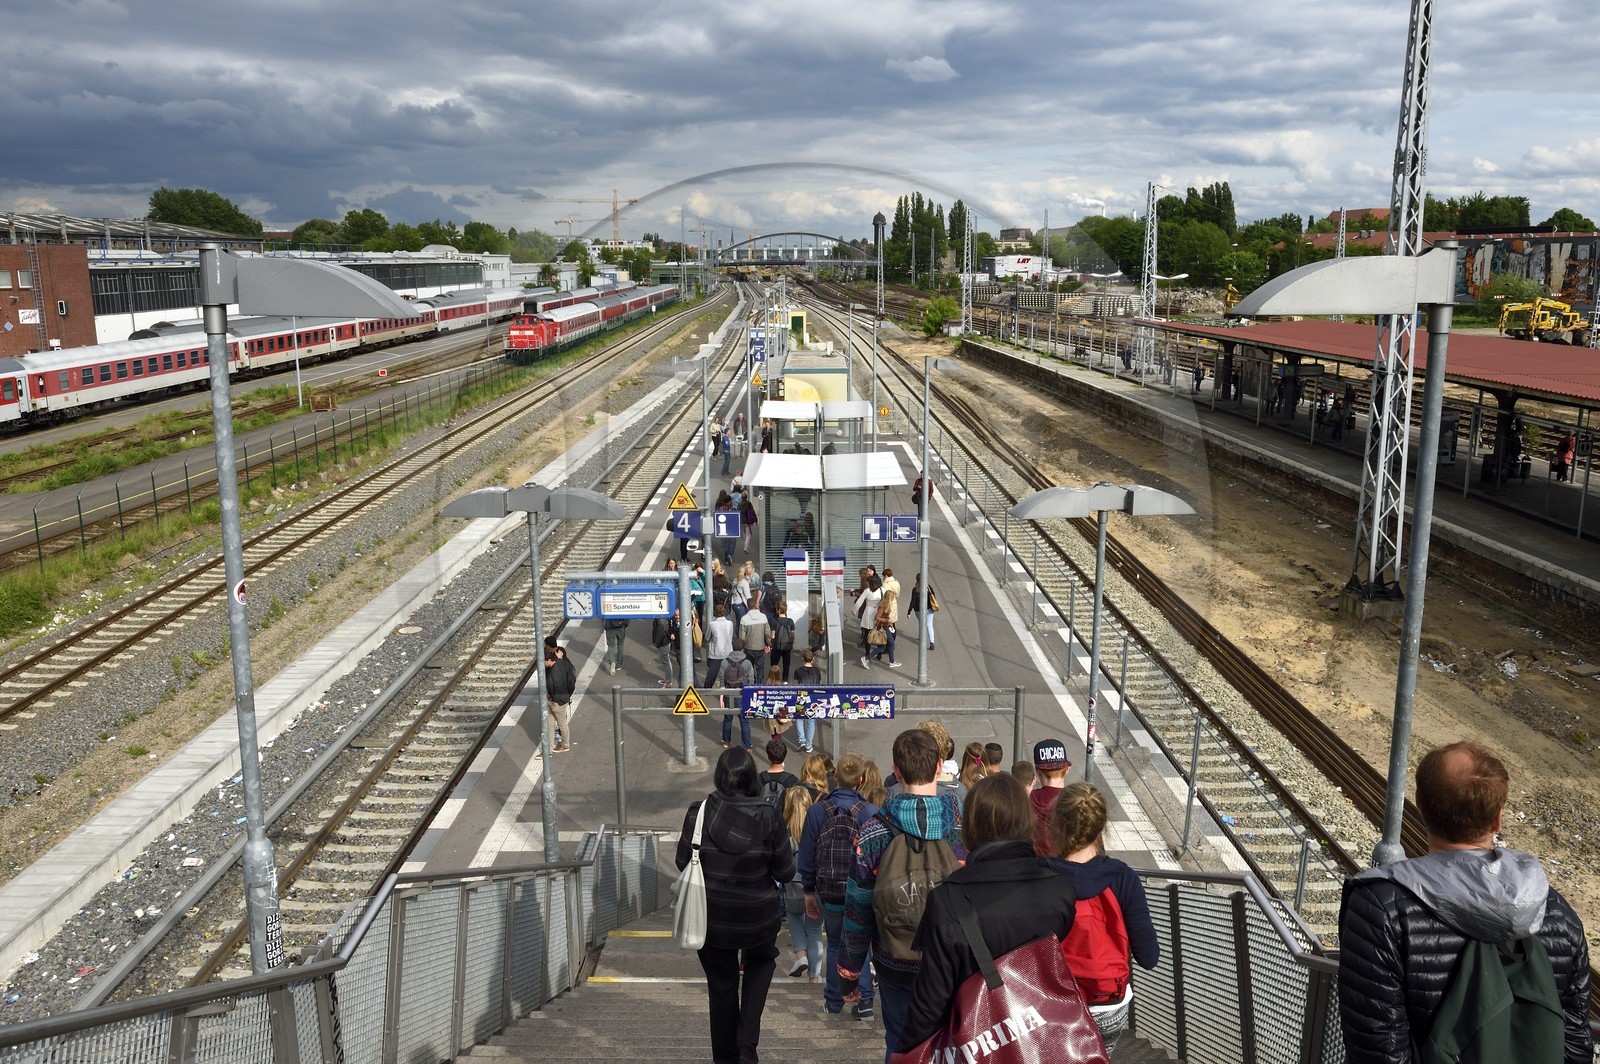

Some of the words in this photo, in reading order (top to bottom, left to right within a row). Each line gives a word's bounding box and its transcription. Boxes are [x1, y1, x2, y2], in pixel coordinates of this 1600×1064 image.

[755, 351, 761, 360] 4
[73, 371, 78, 380] 2
[677, 512, 691, 533] 4
[658, 601, 663, 610] 4
[1039, 747, 1065, 760] CHICAGO
[959, 1005, 1047, 1064] PRIMA
